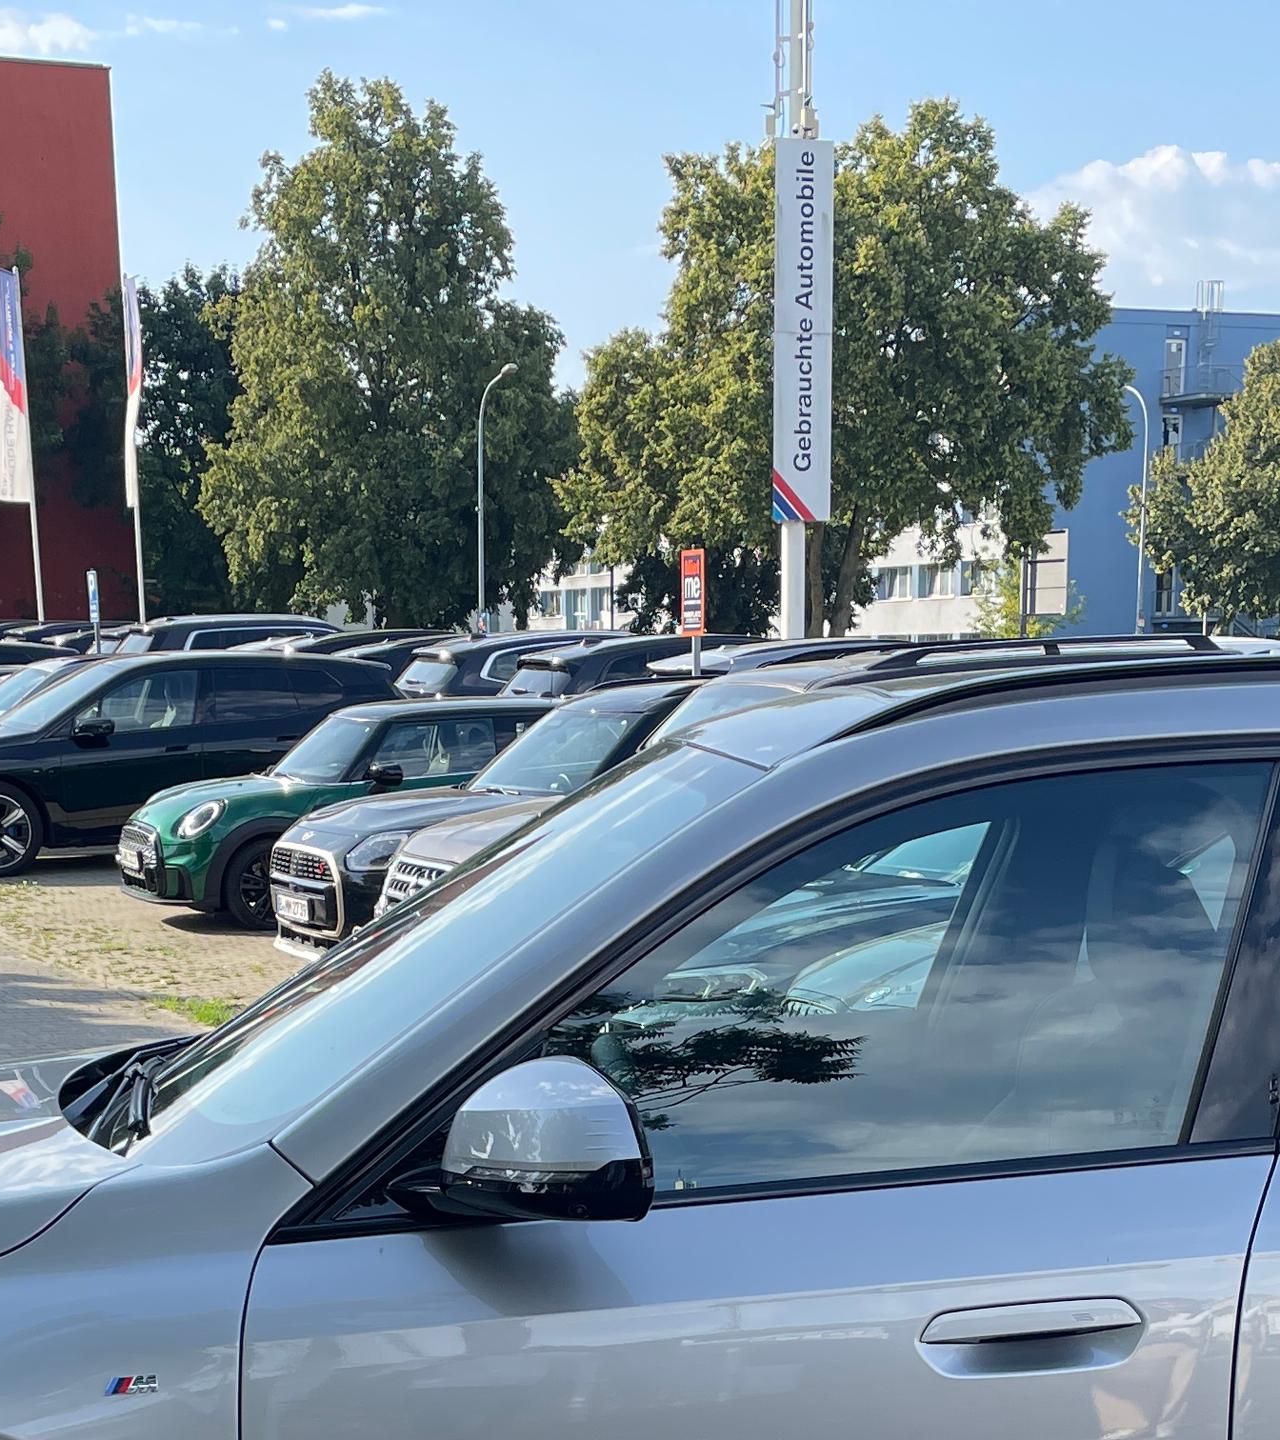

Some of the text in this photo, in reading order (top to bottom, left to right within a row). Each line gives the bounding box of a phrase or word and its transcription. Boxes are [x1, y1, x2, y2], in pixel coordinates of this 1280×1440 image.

[792, 151, 815, 473] Gebrauchte Automobile
[684, 576, 700, 599] me
